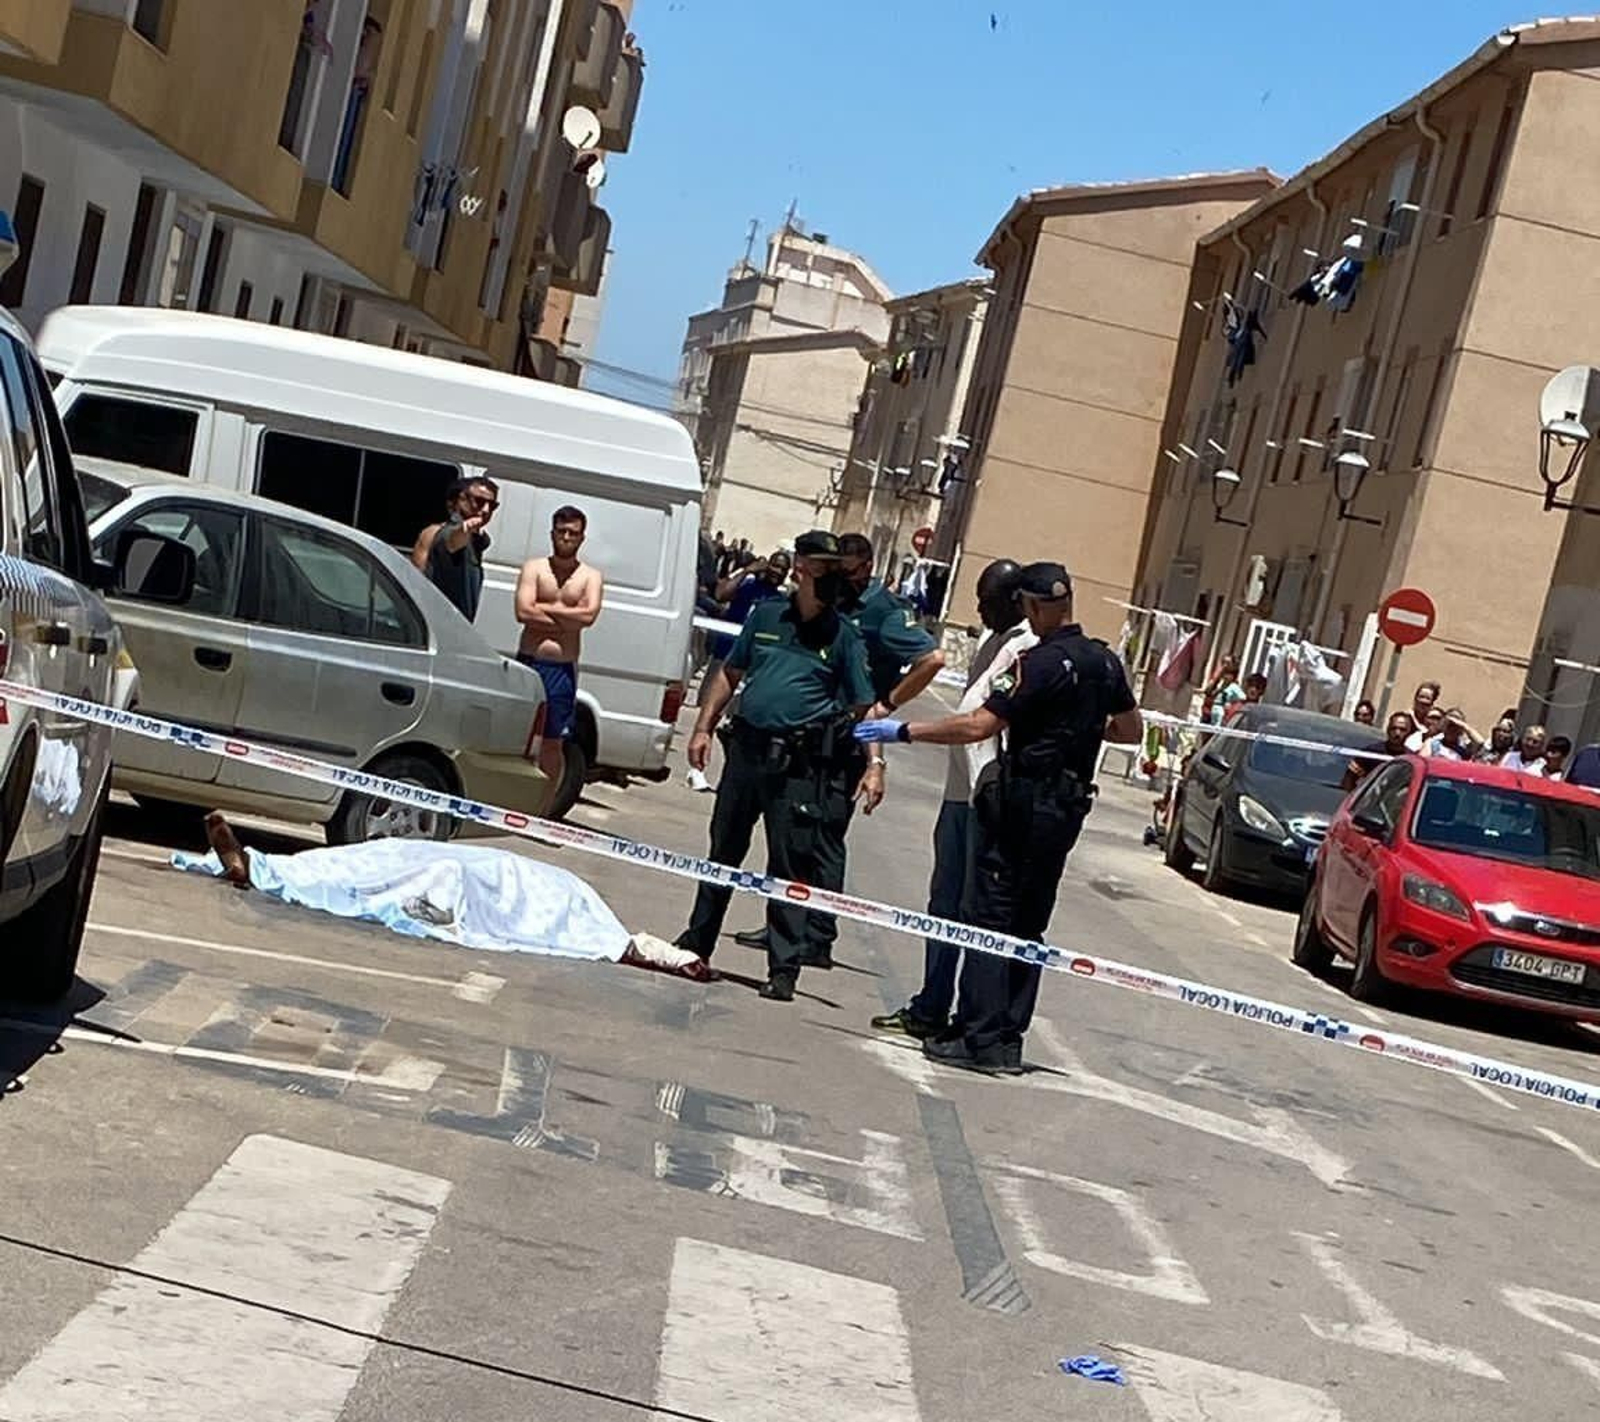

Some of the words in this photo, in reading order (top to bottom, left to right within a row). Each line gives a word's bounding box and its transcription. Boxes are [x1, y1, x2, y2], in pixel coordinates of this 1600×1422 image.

[663, 852, 722, 879] POLICIA
[891, 910, 944, 938] LOCAL
[945, 924, 1006, 953] POLICIA
[1503, 951, 1545, 974] 3404
[1178, 985, 1231, 1012] LOCAL
[1233, 1000, 1294, 1028] POLICIA
[1469, 1063, 1523, 1089] LOCAL
[1525, 1077, 1589, 1106] POLICIA
